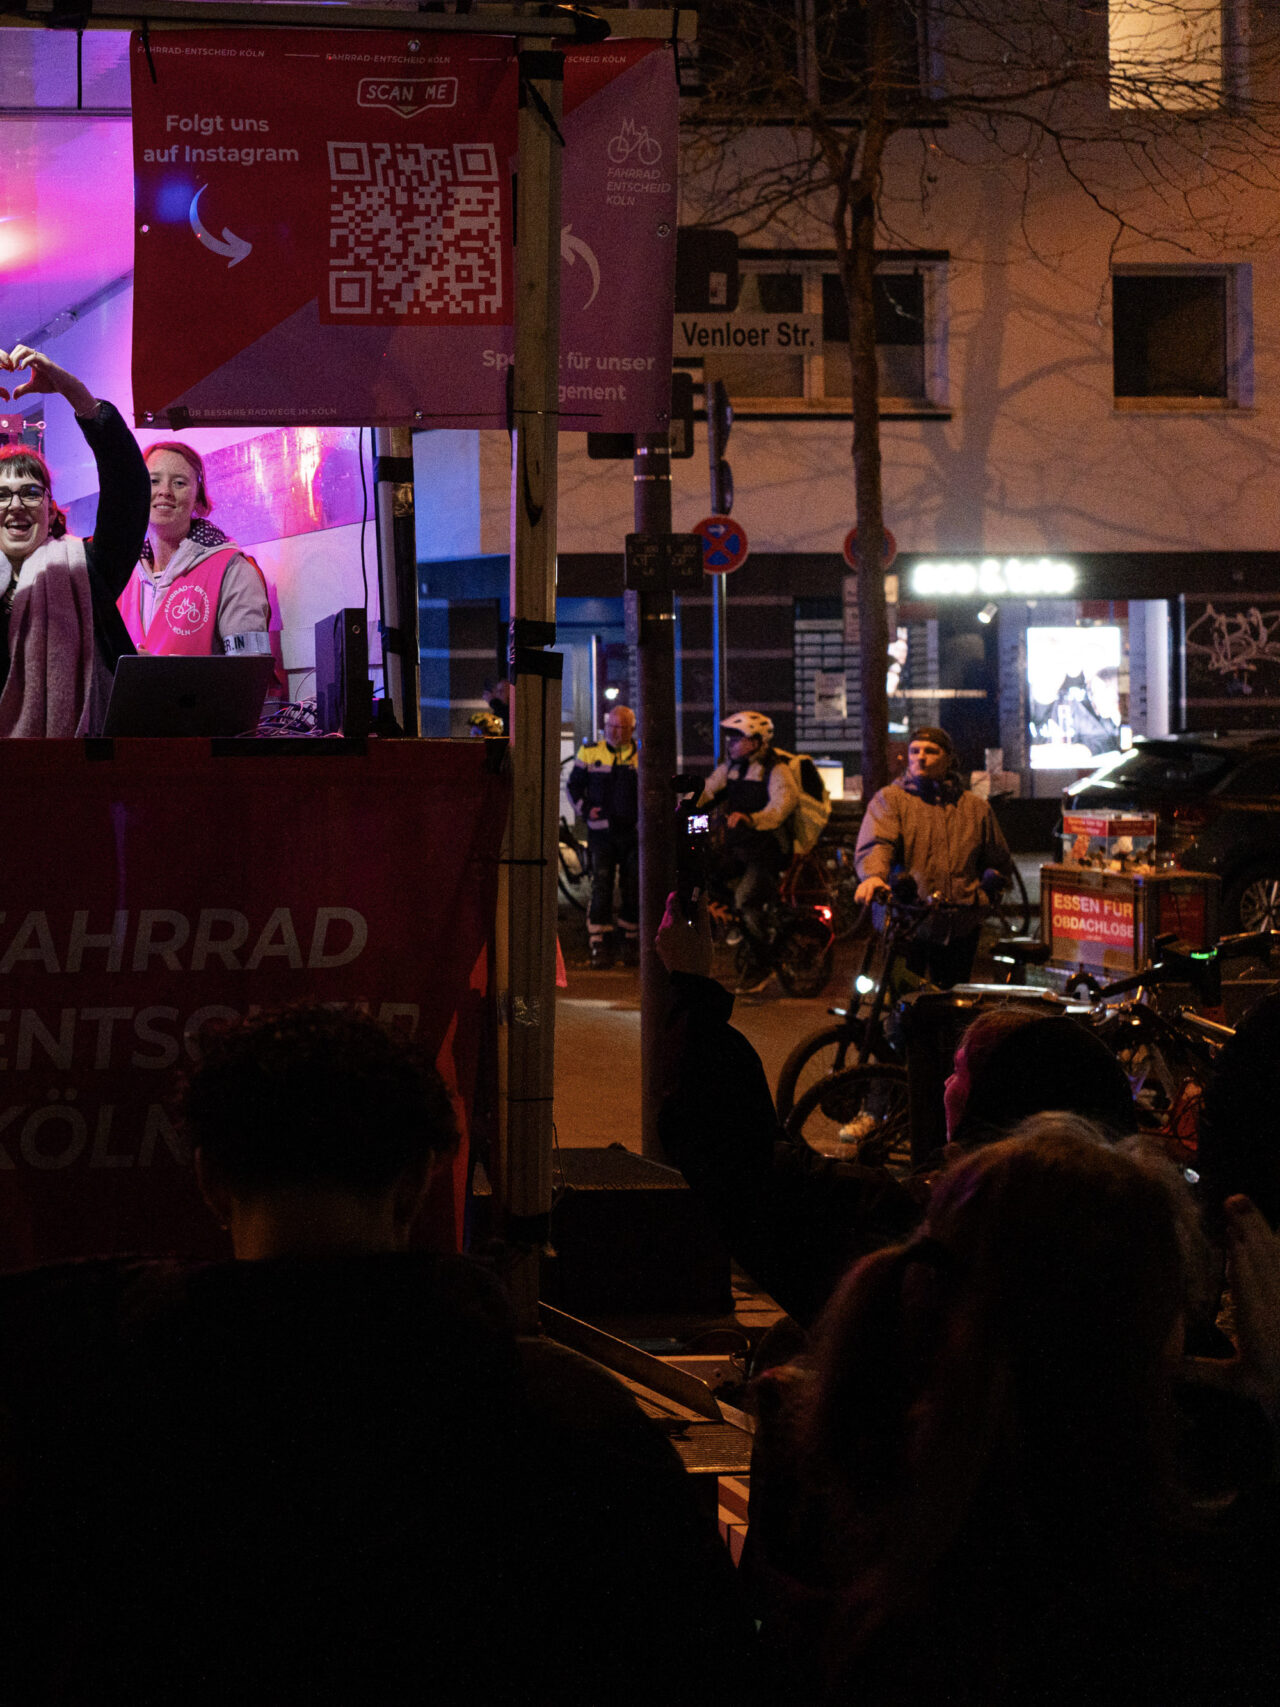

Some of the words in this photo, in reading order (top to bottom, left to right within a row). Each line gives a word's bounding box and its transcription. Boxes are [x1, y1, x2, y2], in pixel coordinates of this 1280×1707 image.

[366, 84, 414, 101] SCAN
[425, 84, 448, 100] ME
[166, 113, 224, 136] Folgt
[230, 118, 270, 133] uns
[143, 145, 179, 163] auf
[185, 145, 300, 166] Instagram
[606, 167, 661, 179] FAHRRAD
[606, 182, 671, 193] ENTSCHEID
[682, 322, 770, 347] Venloer
[777, 322, 814, 347] Str.
[567, 351, 592, 370] für
[596, 356, 656, 371] unser
[1053, 892, 1100, 914] ESSEN
[1052, 914, 1134, 938] OBDACHLOSE
